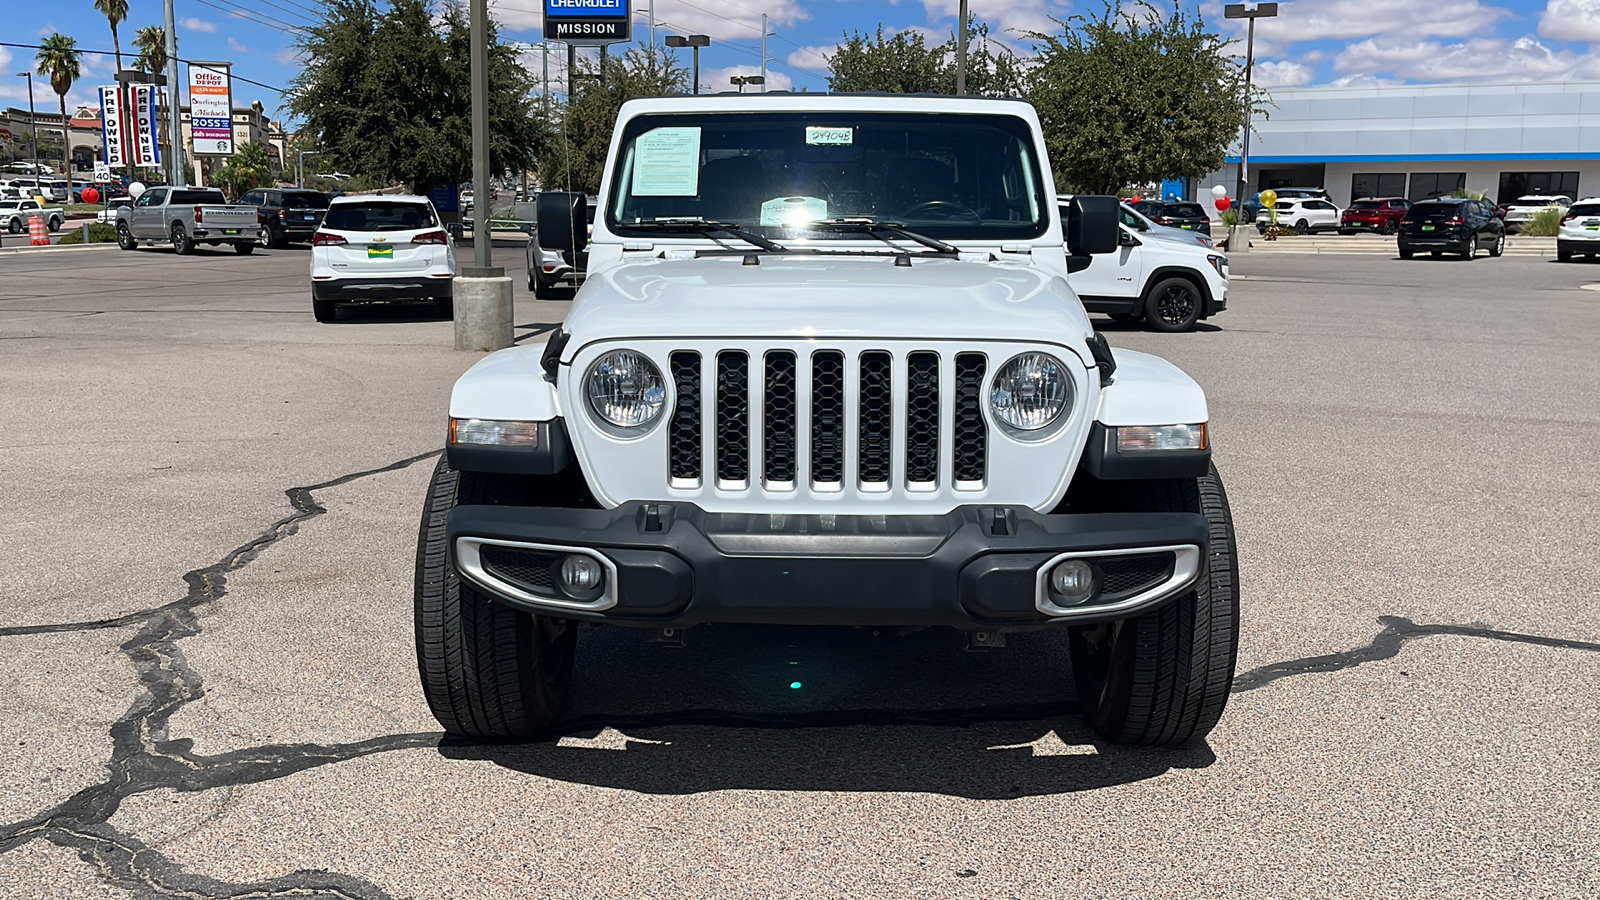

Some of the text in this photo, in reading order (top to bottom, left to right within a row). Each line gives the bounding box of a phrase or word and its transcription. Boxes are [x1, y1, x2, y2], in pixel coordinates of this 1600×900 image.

[557, 23, 615, 34] MISSION
[192, 98, 228, 106] Burlington
[192, 119, 220, 127] ROSS
[96, 172, 109, 180] 40
